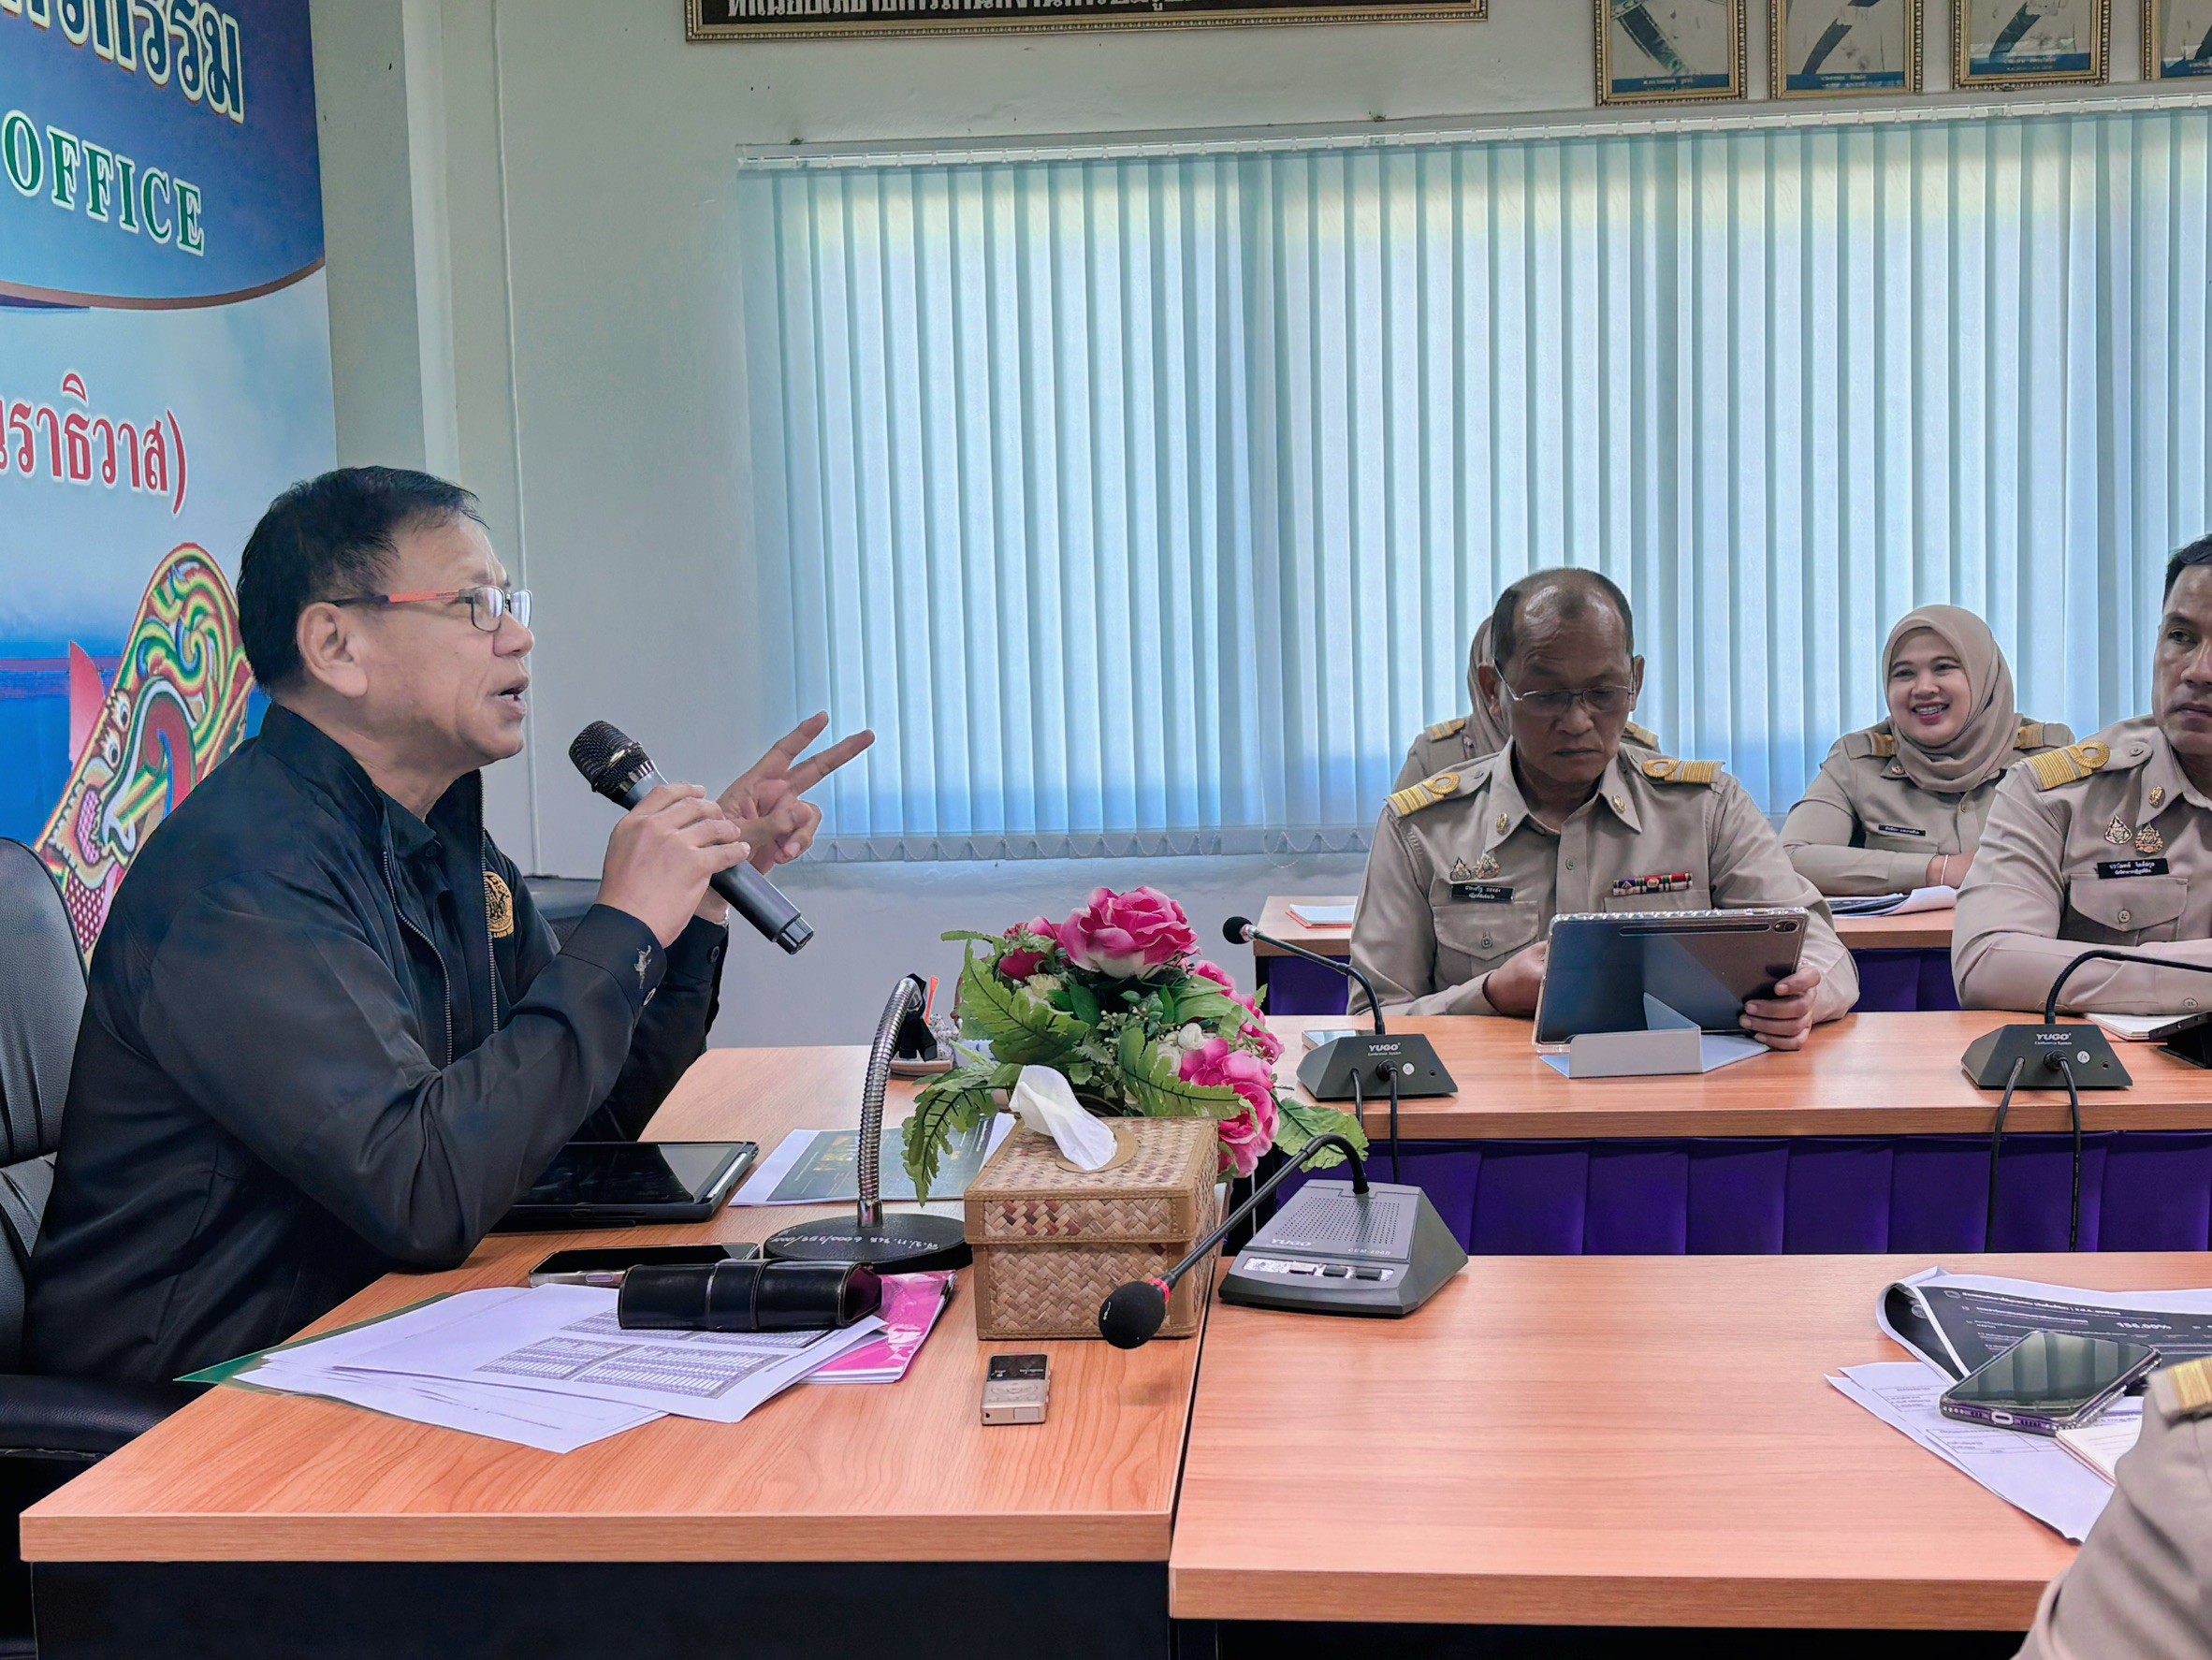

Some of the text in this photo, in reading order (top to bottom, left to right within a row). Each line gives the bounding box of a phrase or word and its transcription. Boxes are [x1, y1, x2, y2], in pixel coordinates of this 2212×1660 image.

[2, 110, 203, 256] OFFICE
[1369, 1043, 1399, 1052] YUGO
[1272, 1238, 1312, 1246] YUGO
